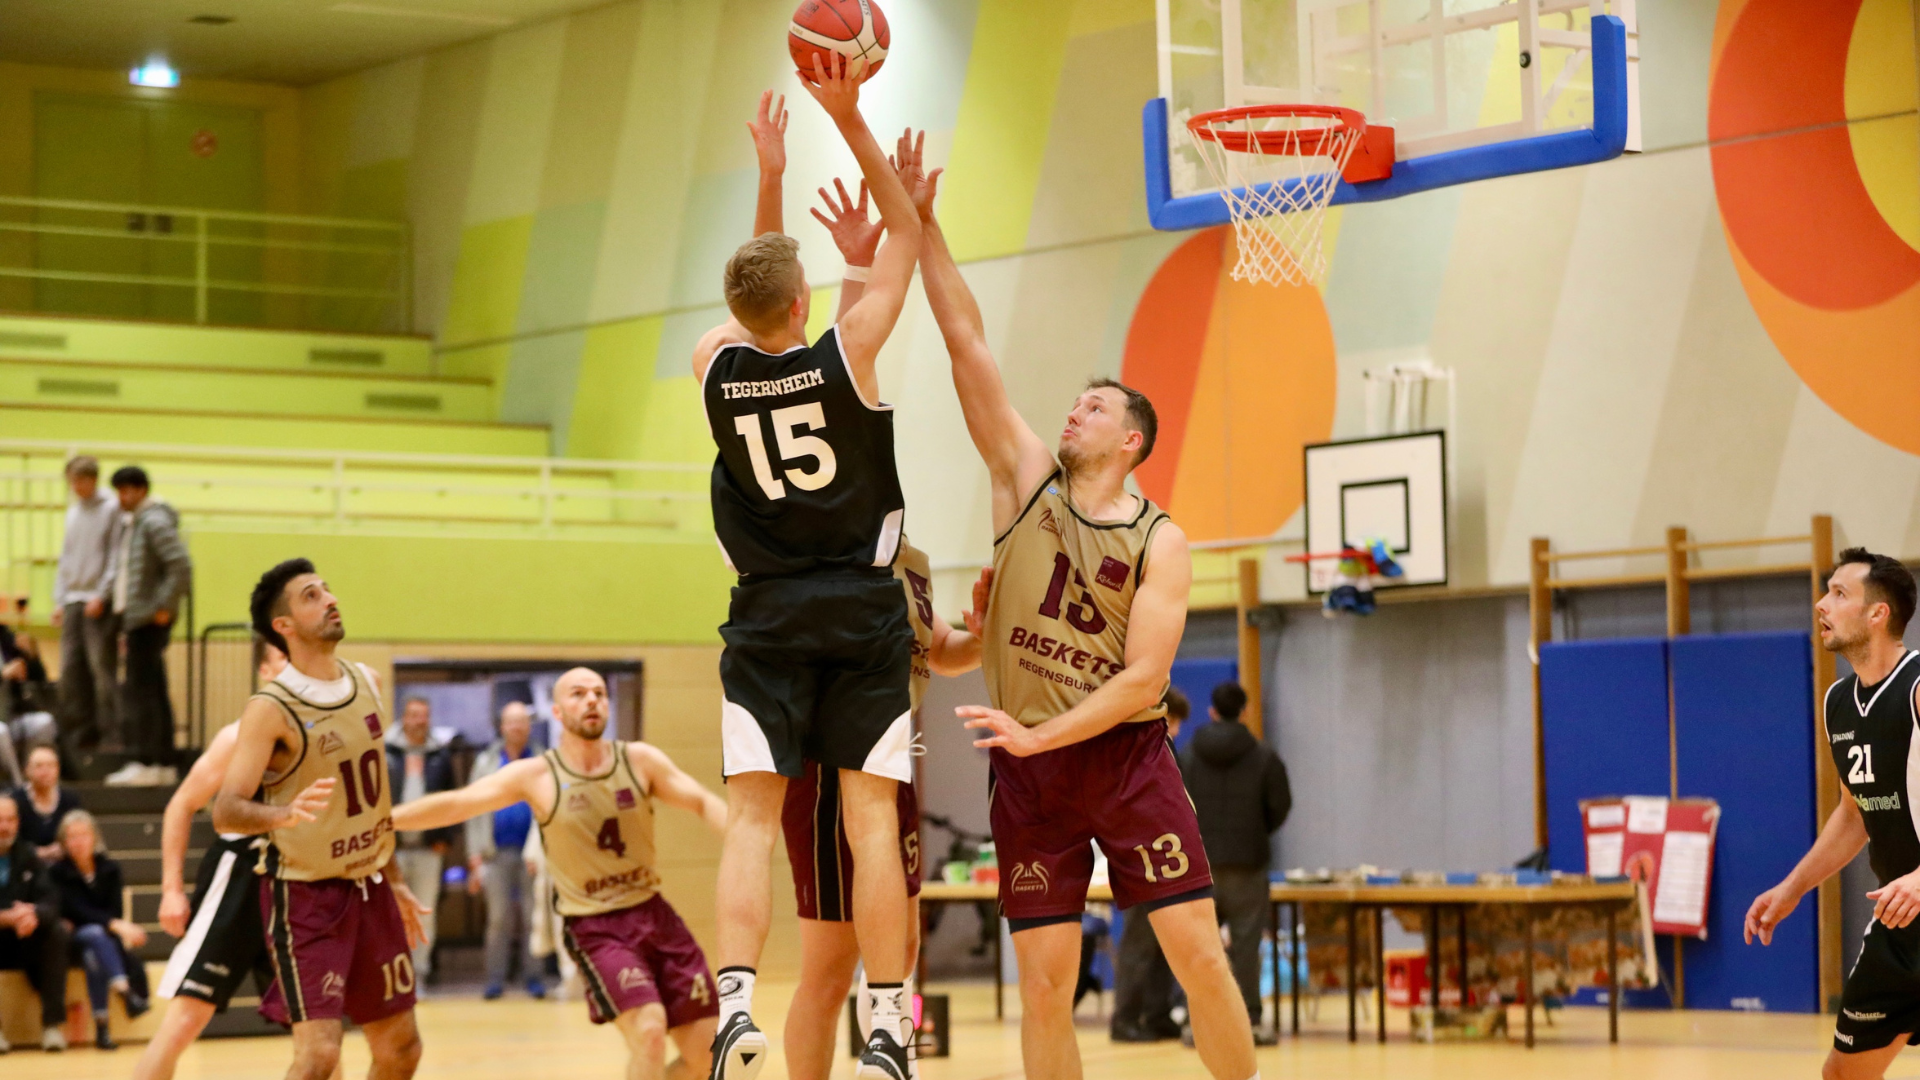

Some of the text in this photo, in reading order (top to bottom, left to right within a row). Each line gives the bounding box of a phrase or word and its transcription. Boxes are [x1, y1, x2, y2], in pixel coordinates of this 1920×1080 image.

[721, 368, 825, 399] TEGERNHEIM
[734, 401, 837, 501] 15
[1038, 551, 1107, 635] 13
[339, 749, 382, 818] 10
[1847, 743, 1876, 784] 21
[597, 817, 626, 858] 4
[904, 831, 919, 875] 5
[1133, 833, 1190, 883] 13
[381, 953, 414, 1001] 10
[690, 972, 710, 1006] 4
